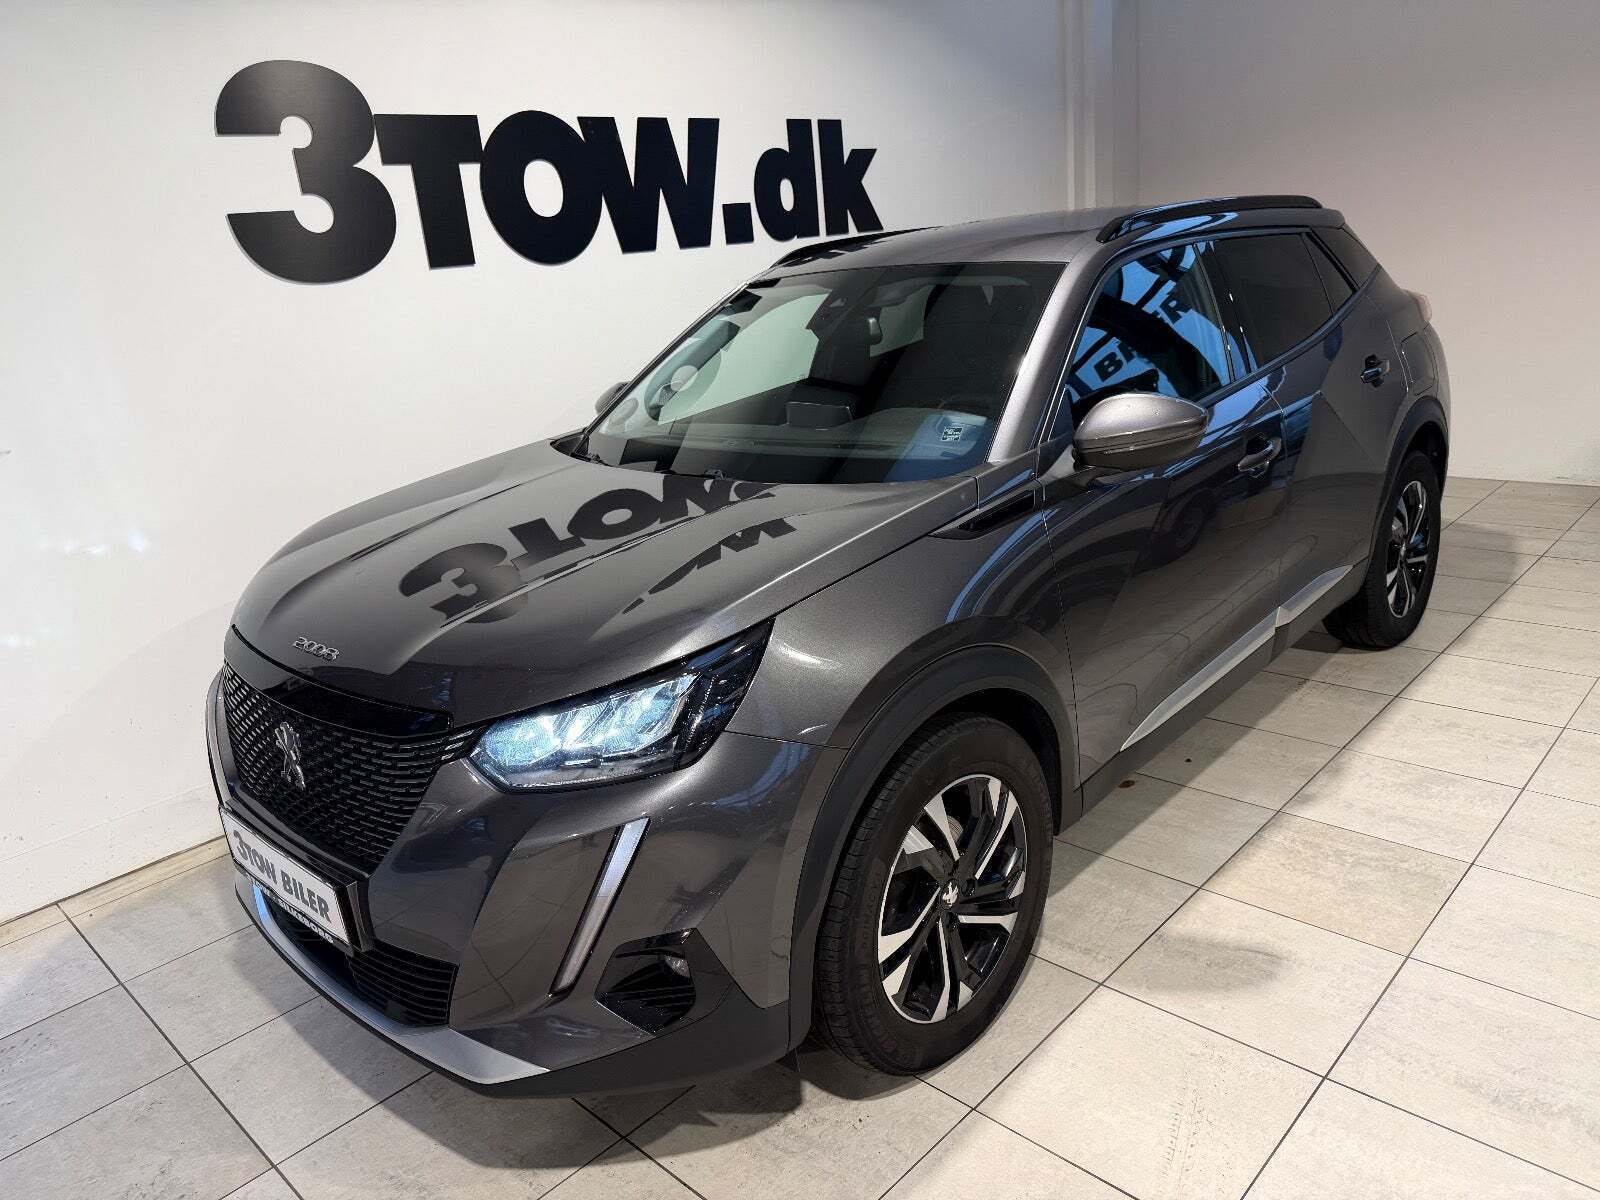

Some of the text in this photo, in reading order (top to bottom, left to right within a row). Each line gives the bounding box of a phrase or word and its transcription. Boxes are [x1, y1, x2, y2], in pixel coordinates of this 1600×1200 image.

[214, 59, 884, 284] 3TOW.dk
[292, 636, 339, 660] 2008
[233, 830, 332, 924] 3TOW BILER
